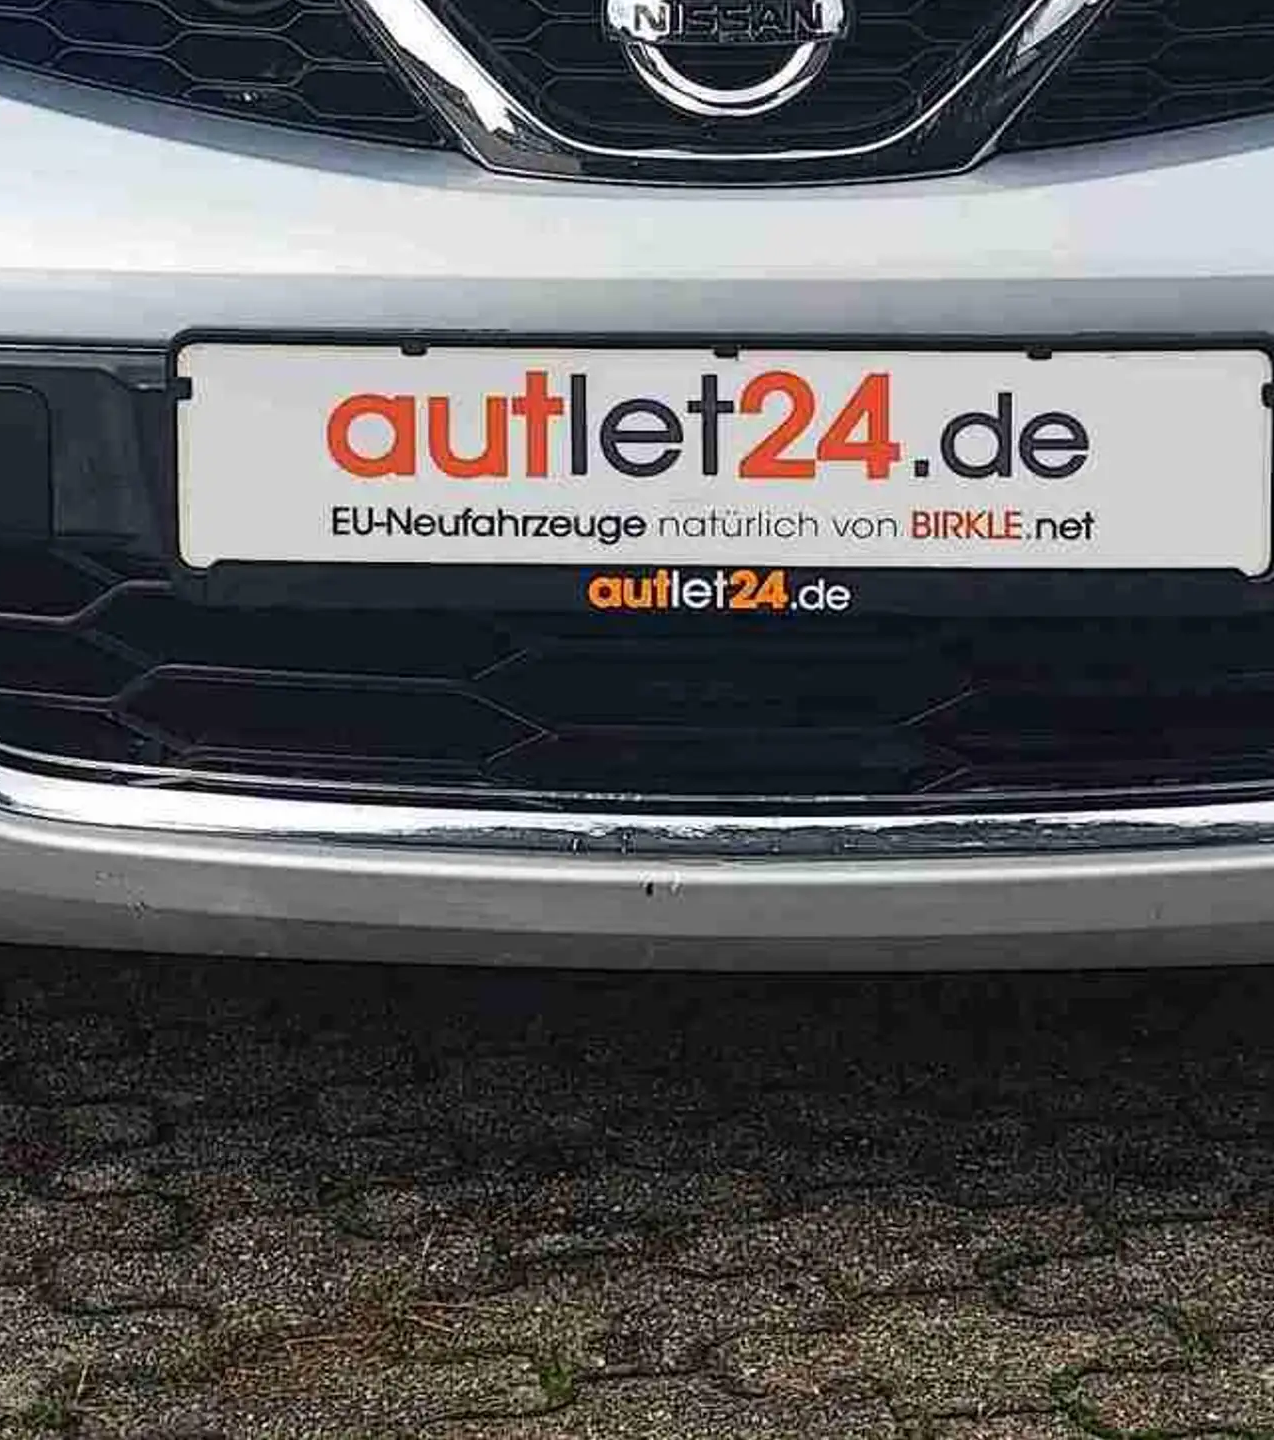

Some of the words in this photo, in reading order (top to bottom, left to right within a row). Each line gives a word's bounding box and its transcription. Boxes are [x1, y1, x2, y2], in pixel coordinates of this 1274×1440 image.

[632, 2, 825, 40] NISSAN
[327, 370, 1090, 481] autlet24.de
[331, 506, 647, 544] EU-Neufahrzeuge
[659, 506, 819, 541] natürlich
[832, 514, 899, 540] von
[911, 509, 1096, 541] BIRKLE.net
[588, 569, 852, 612] autlet24.de
